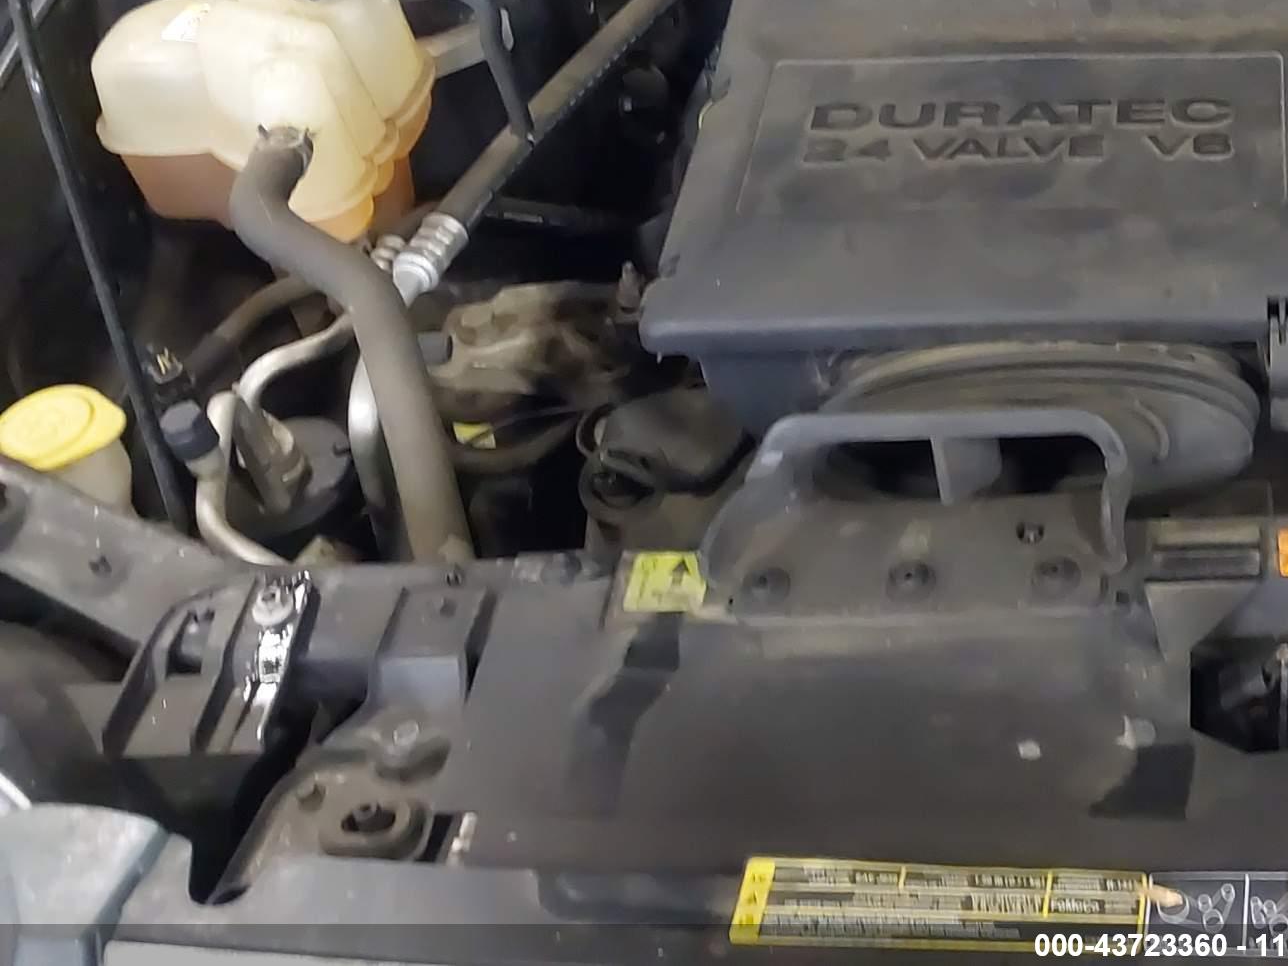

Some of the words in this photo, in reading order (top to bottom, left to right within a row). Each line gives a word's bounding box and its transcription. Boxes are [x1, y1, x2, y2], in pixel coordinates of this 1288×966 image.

[810, 98, 1235, 130] DURATEC
[802, 137, 892, 163] 24
[912, 135, 1105, 161] VALVE
[1146, 133, 1234, 159] V6
